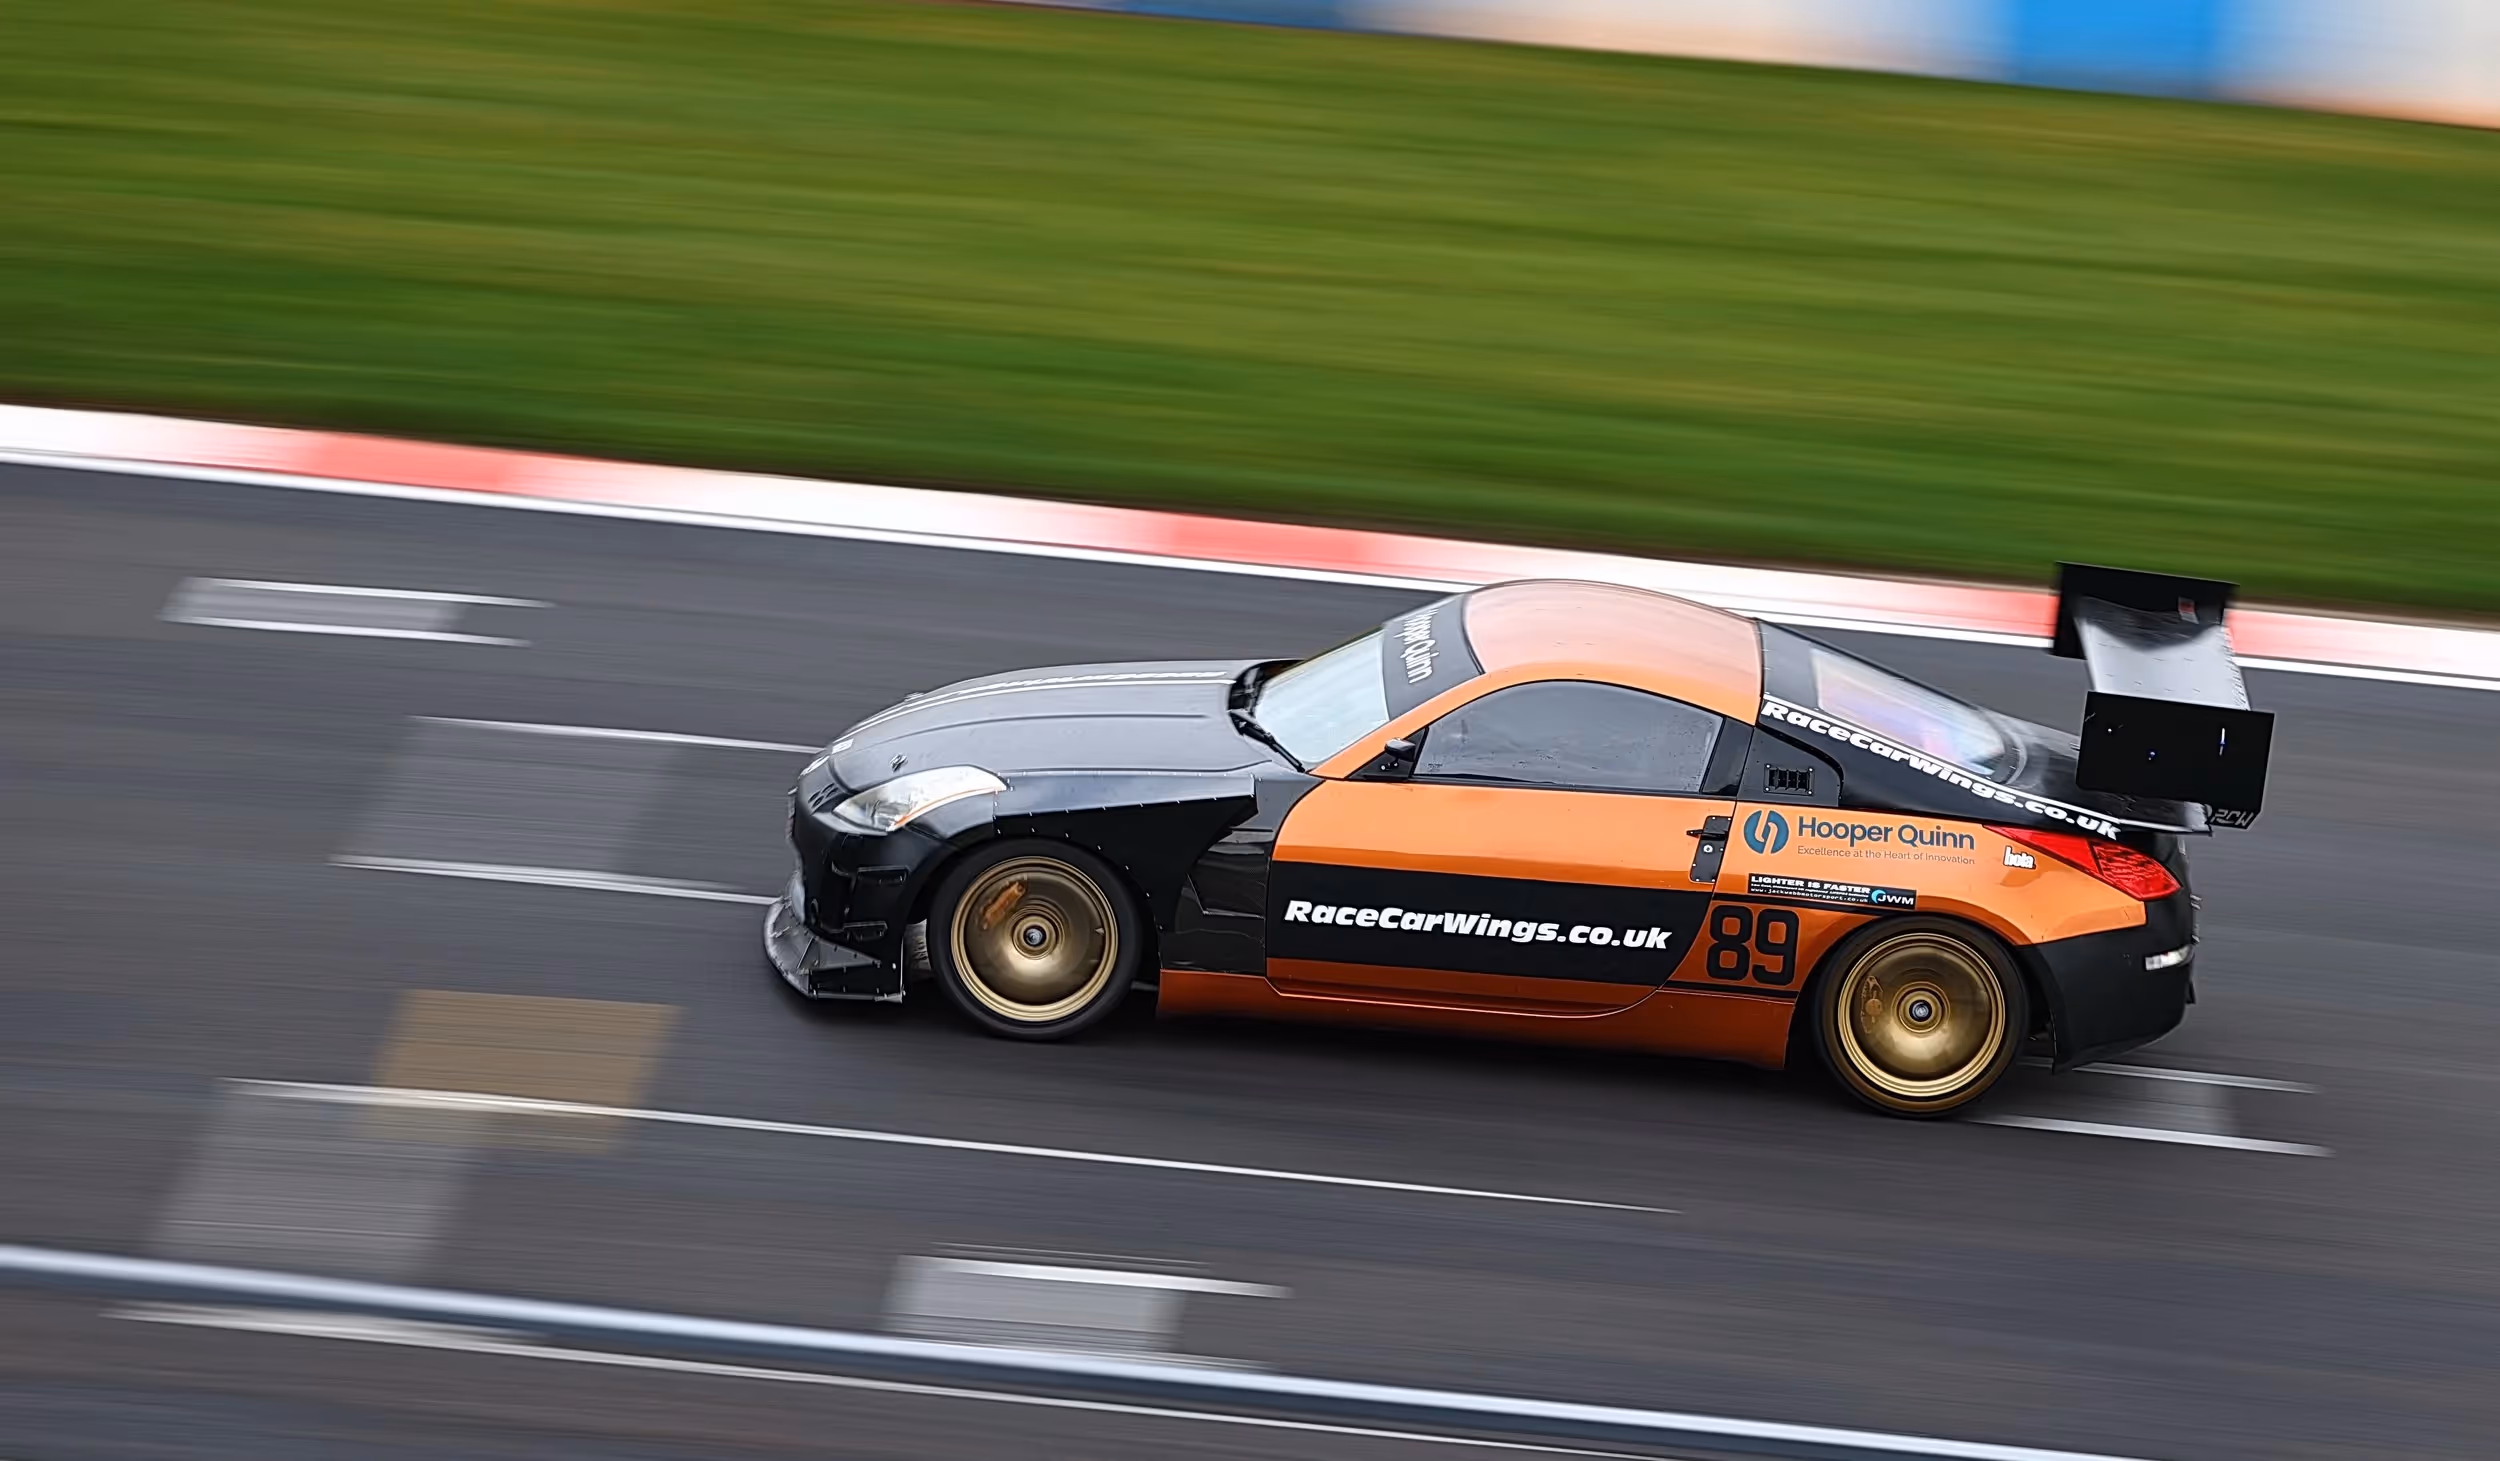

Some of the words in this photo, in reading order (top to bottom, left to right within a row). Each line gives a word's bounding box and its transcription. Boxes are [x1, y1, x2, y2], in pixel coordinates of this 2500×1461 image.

[1400, 640, 1440, 684] Quinn
[1798, 816, 1892, 847] Hooper
[1898, 823, 1975, 850] Quinn
[1797, 845, 1850, 857] Excellence
[1853, 850, 1863, 858] at
[1865, 849, 1881, 859] the
[1884, 850, 1910, 860] Heart
[1913, 852, 1923, 861] of
[1925, 852, 1976, 865] Innovation
[1751, 876, 1804, 887] LIGHTER
[1808, 881, 1820, 889] IS
[1823, 883, 1870, 894] FASTER
[1877, 894, 1914, 905] JWM
[1284, 900, 1672, 949] RaceCarWings.co.uk
[1706, 904, 1800, 987] 89
